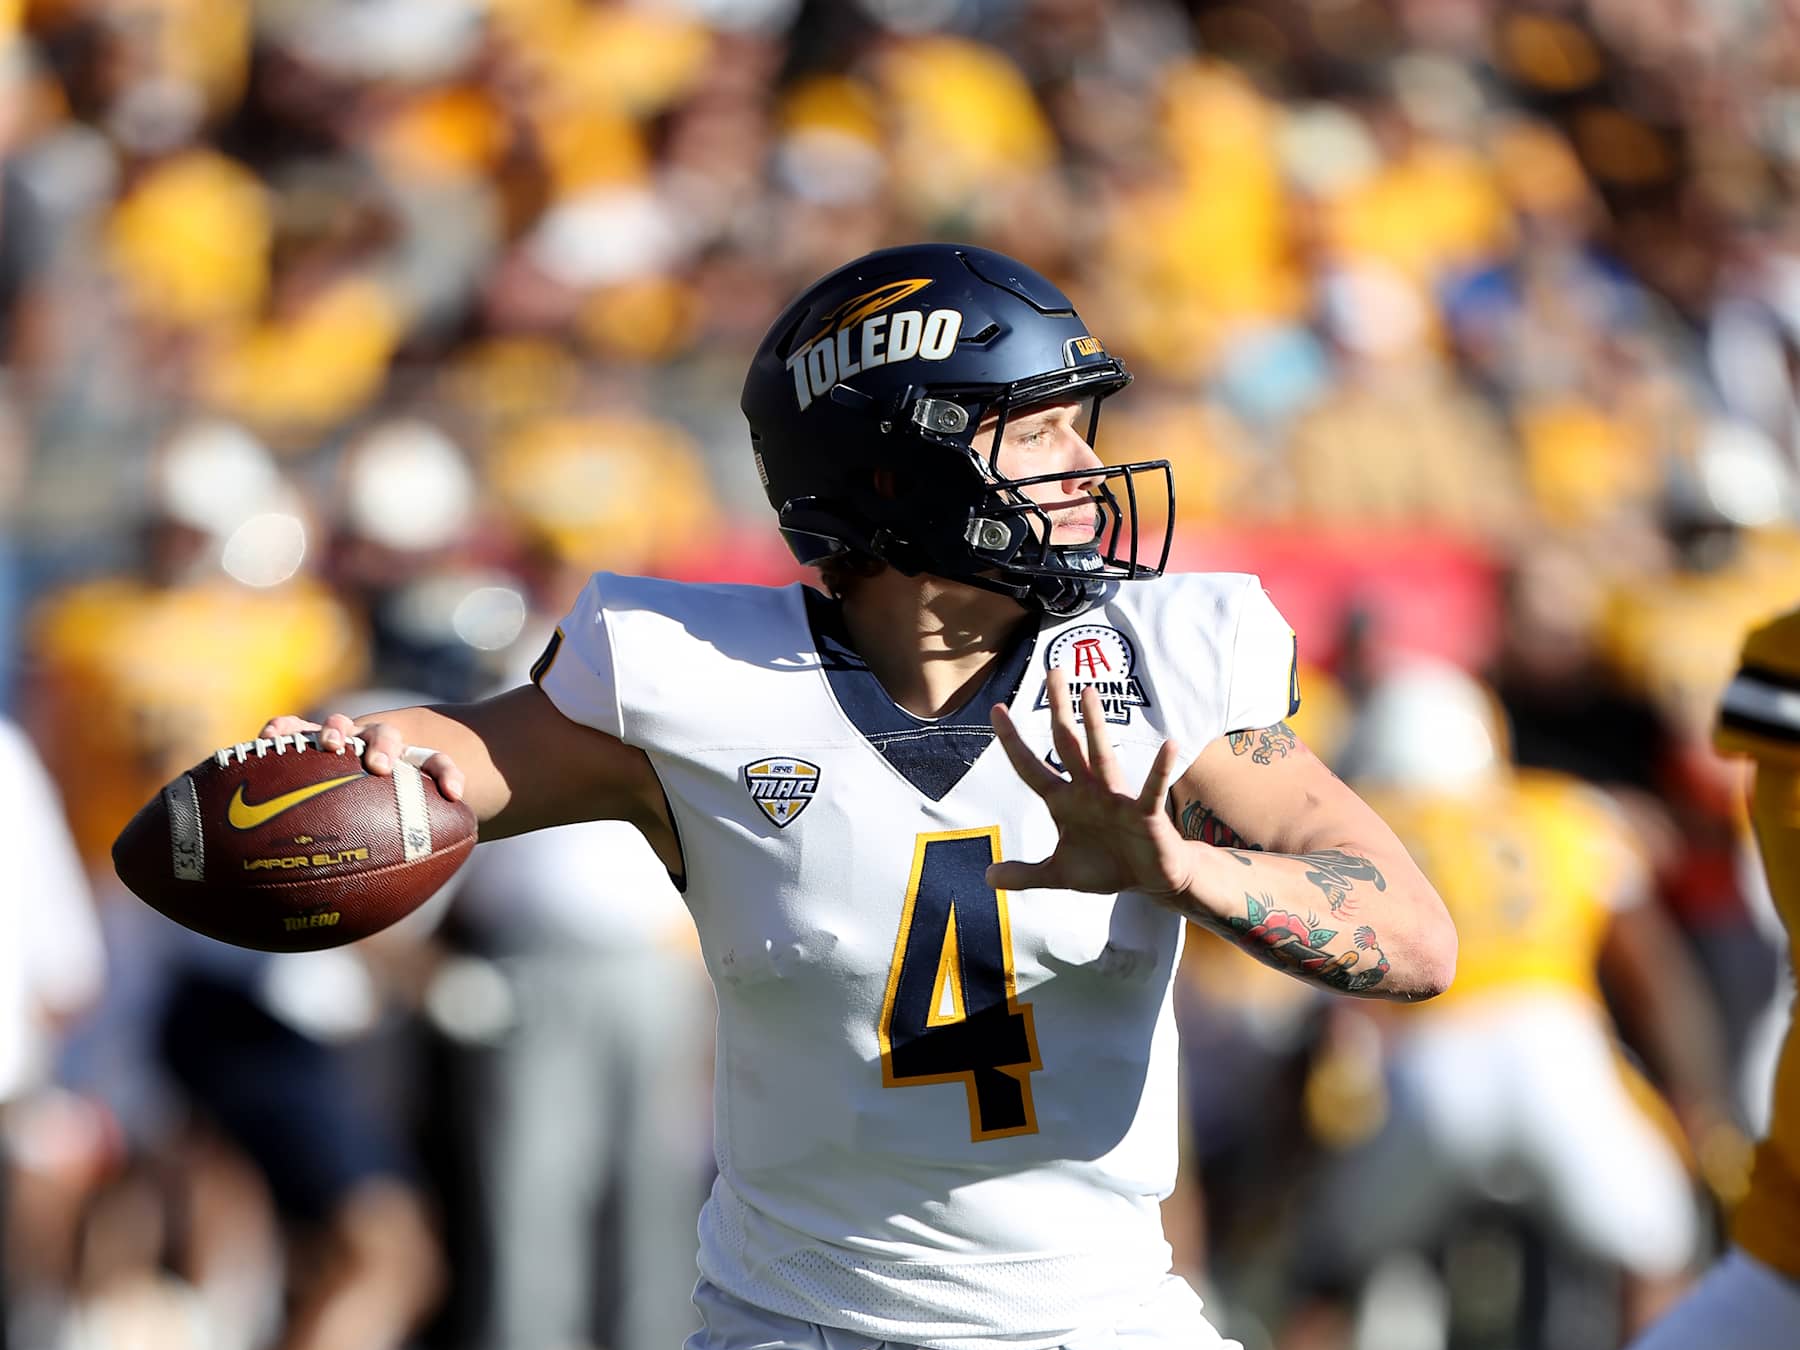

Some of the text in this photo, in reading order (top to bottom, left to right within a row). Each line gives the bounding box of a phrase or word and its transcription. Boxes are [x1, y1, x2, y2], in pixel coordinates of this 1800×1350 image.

[786, 309, 962, 412] TOLEDO
[1046, 681, 1141, 699] IONA
[750, 780, 816, 798] MAC
[243, 848, 369, 870] VAPOR ELITE
[283, 912, 340, 931] TOLEDO
[878, 825, 1043, 1143] 4
